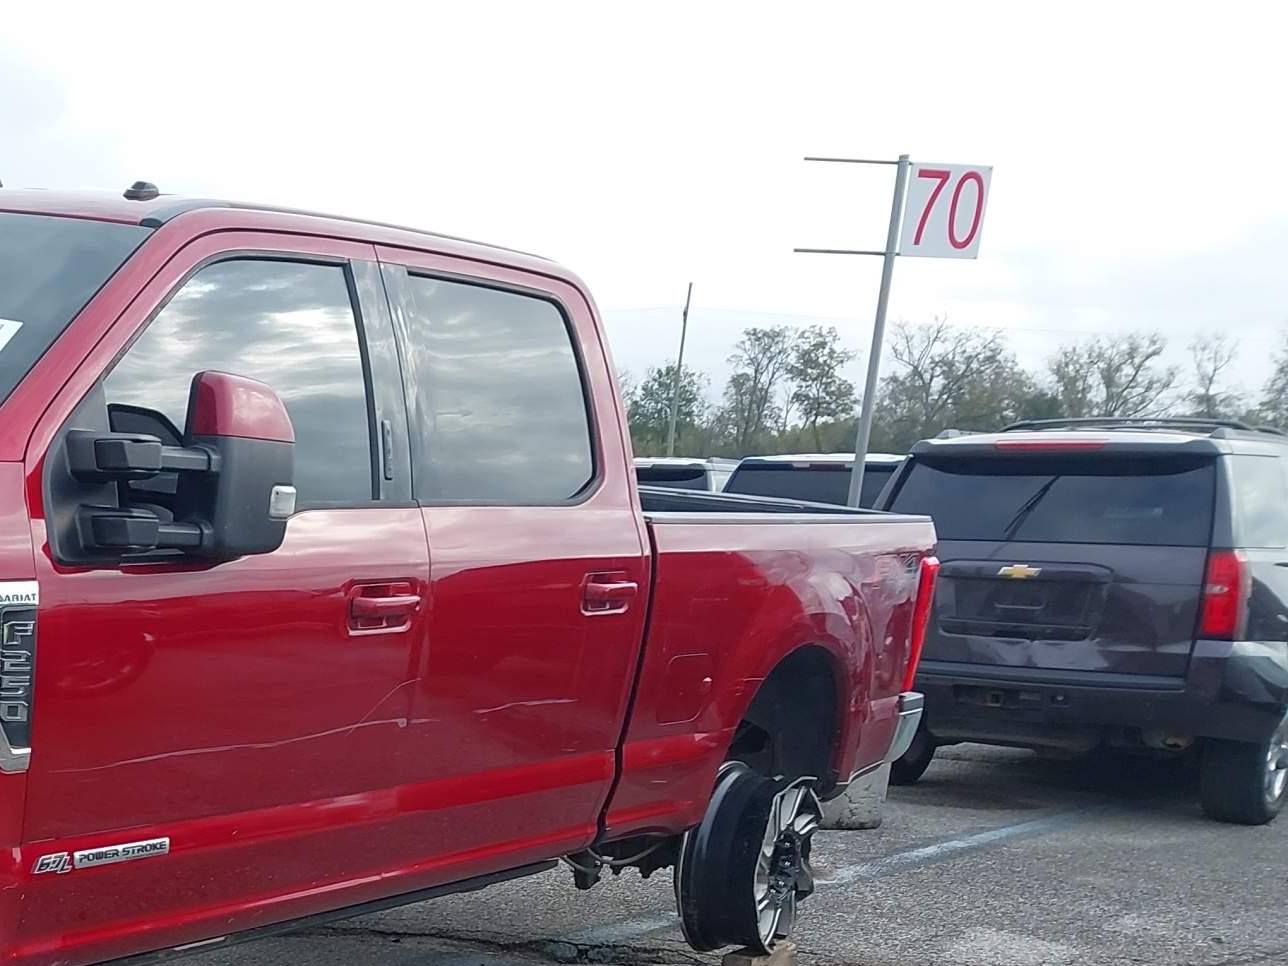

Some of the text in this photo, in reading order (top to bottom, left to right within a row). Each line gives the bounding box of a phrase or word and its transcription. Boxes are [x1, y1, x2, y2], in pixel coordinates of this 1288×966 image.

[912, 168, 984, 250] 70
[78, 840, 168, 864] POWER STROKE
